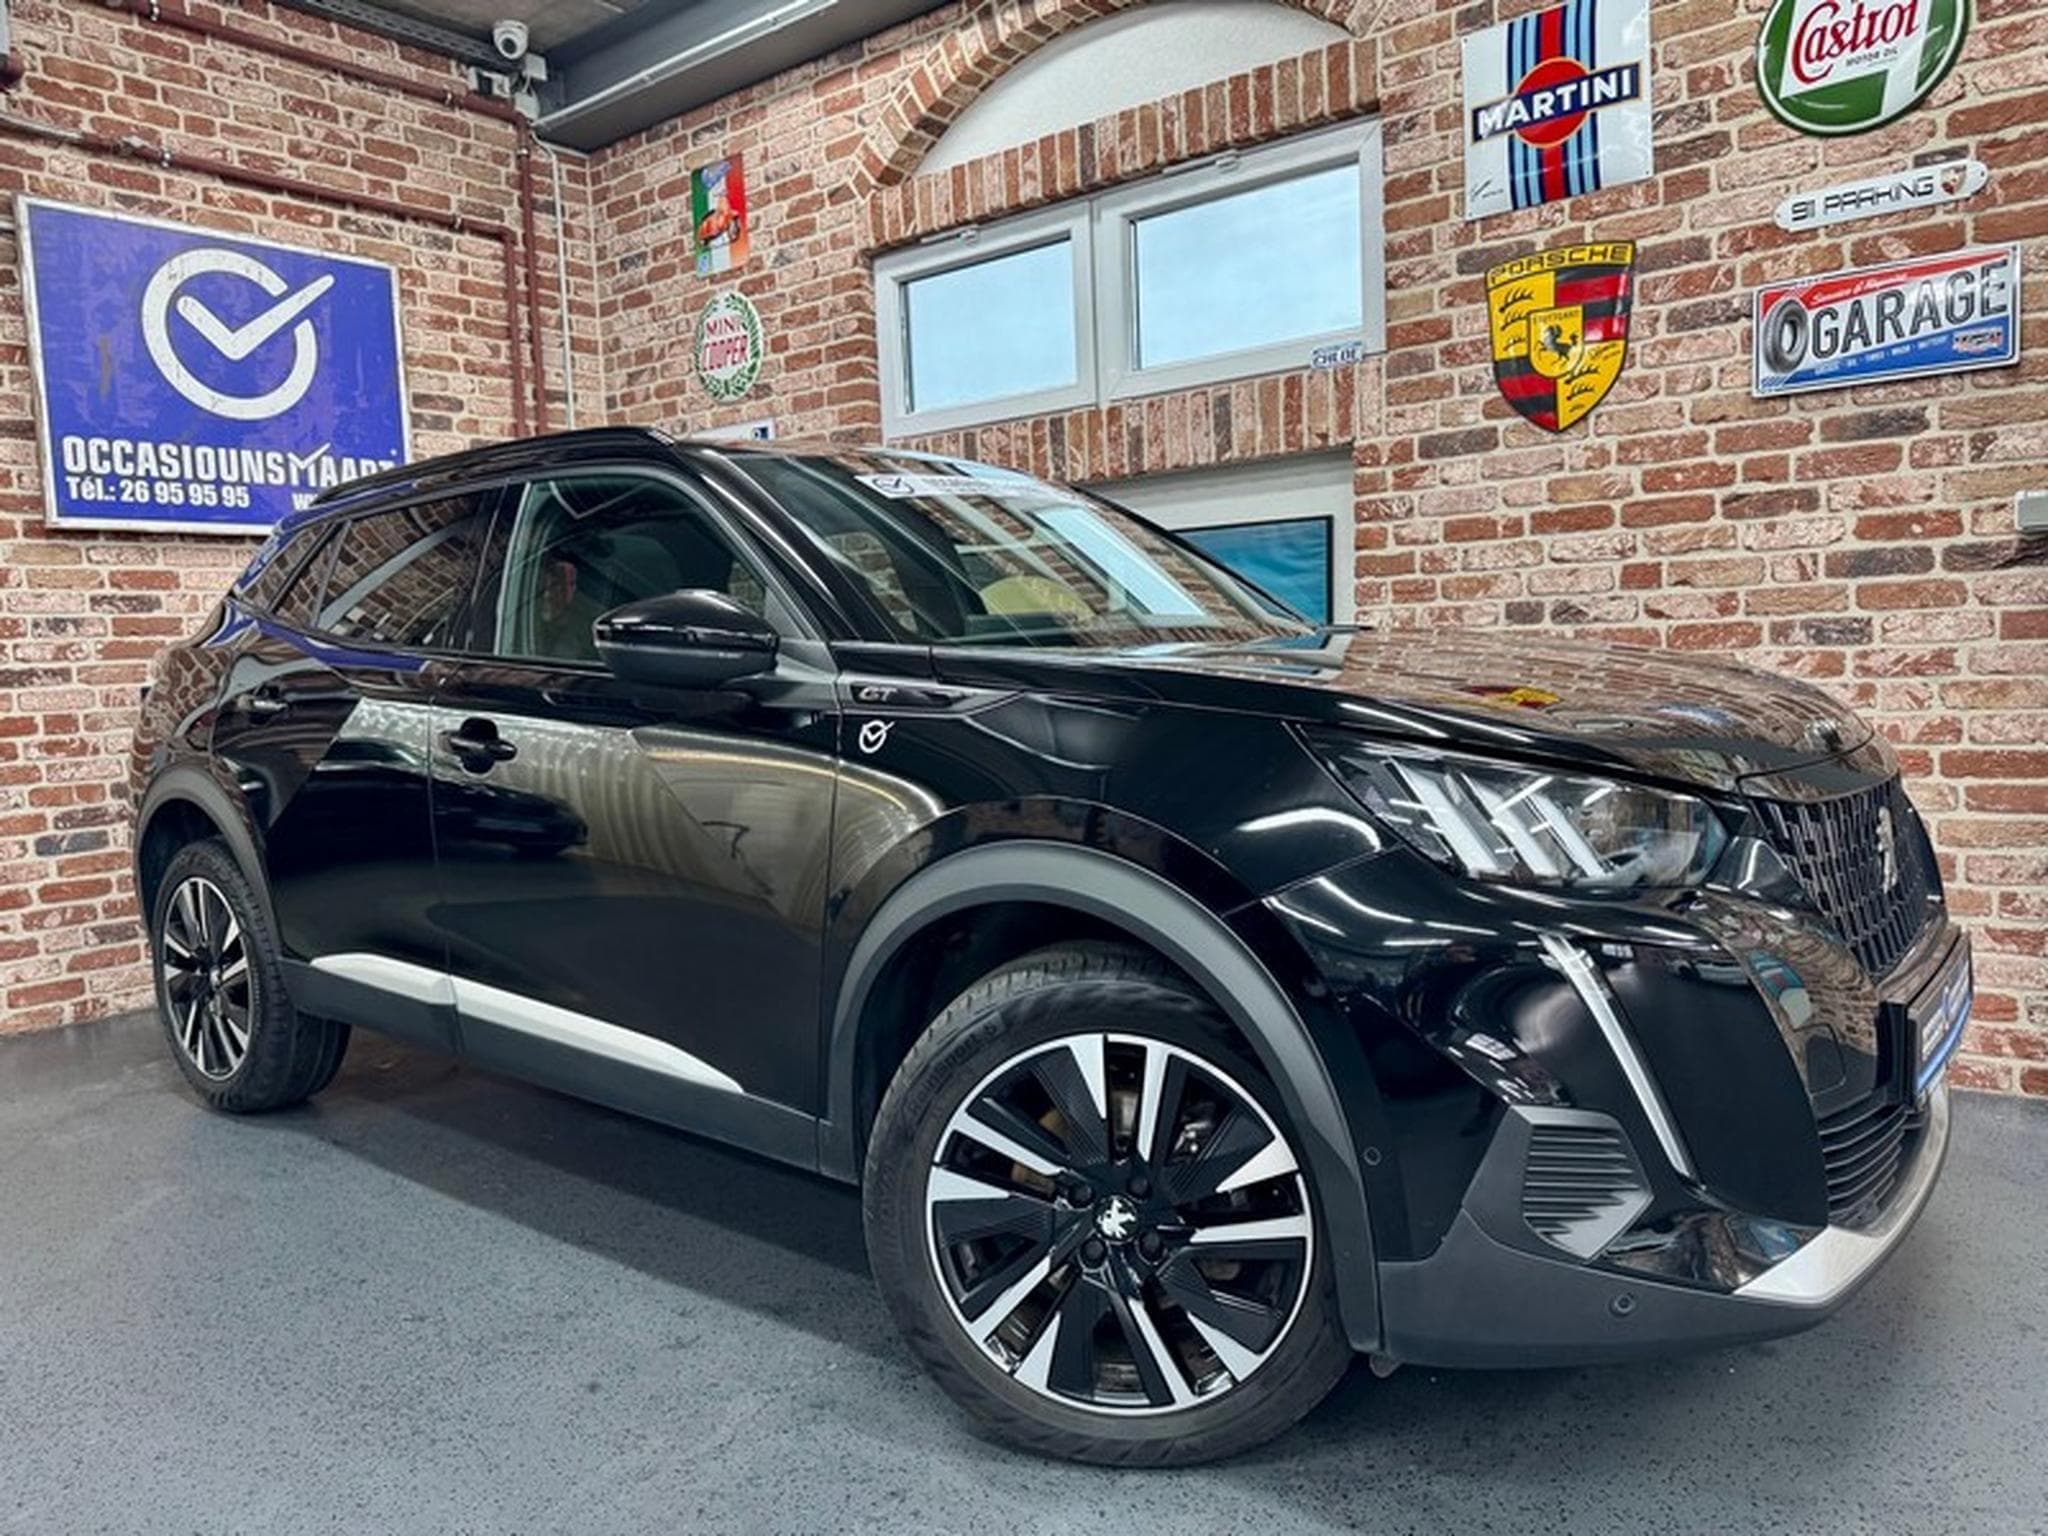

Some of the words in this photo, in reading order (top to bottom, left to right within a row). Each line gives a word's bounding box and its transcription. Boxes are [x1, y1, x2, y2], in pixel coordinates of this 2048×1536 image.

[1792, 0, 1919, 84] Castrol
[1477, 69, 1632, 139] MARTINI
[1824, 175, 1934, 215] PARKING
[1490, 244, 1628, 284] PORSCHE
[706, 316, 749, 336] MINI
[703, 334, 748, 371] COOPER
[66, 477, 115, 500] Tél.:
[120, 478, 149, 503] 26
[155, 480, 184, 505] 95
[189, 482, 218, 507] 95
[222, 484, 250, 508] 95
[859, 686, 898, 701] GT
